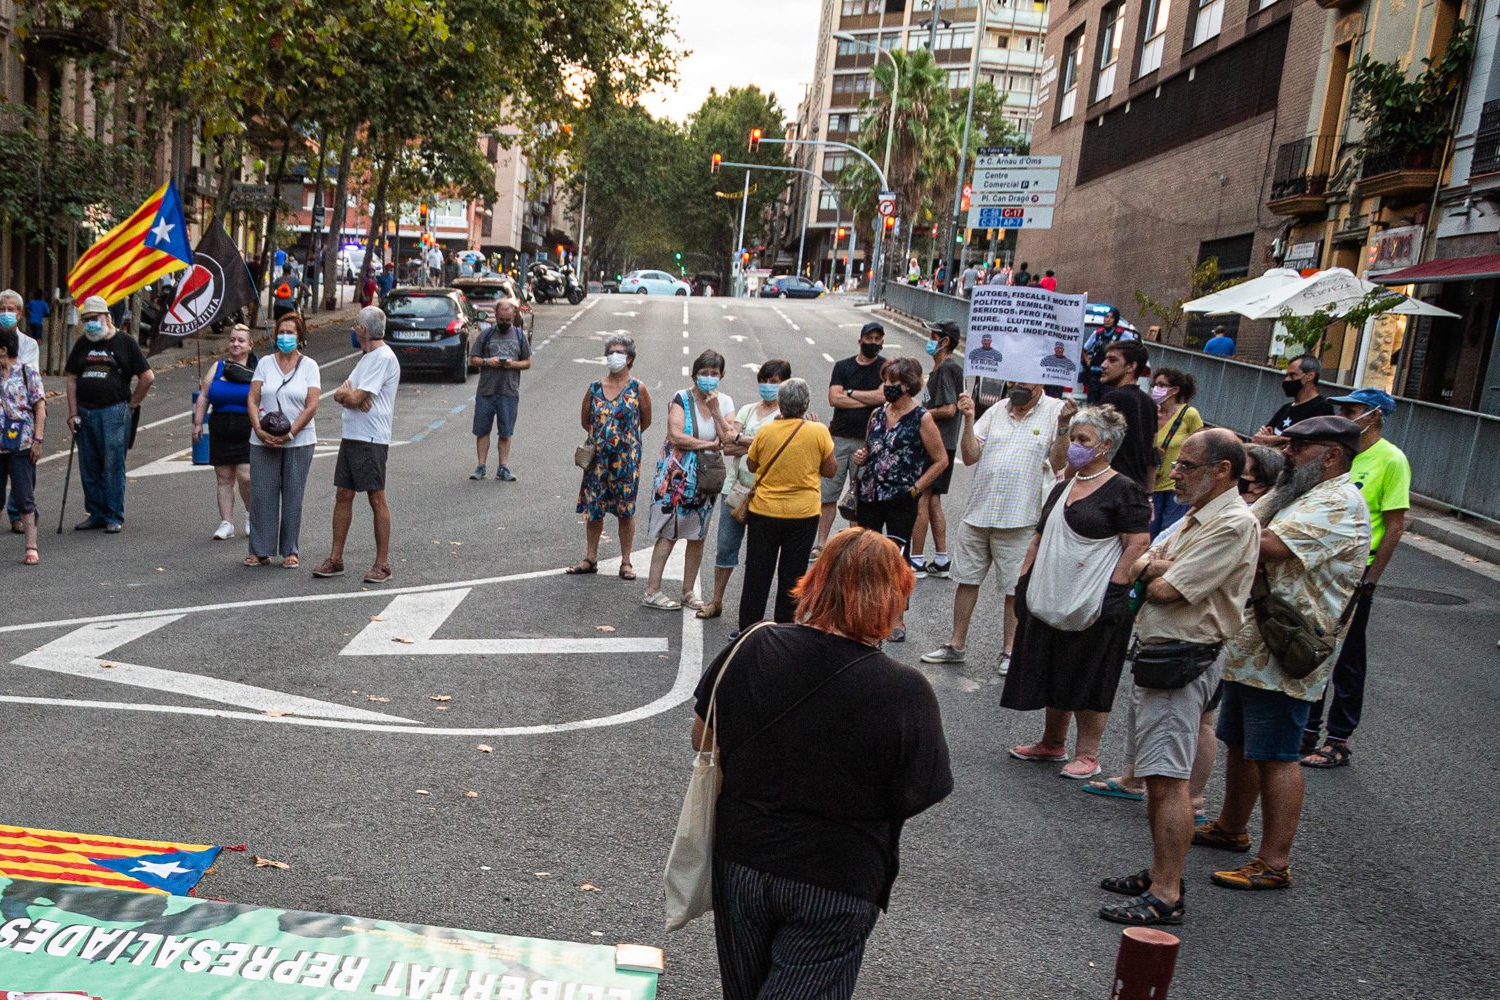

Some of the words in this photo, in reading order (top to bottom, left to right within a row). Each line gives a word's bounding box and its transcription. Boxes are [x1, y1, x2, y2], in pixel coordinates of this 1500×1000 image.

[996, 157, 1017, 166] Arnau
[1019, 157, 1042, 166] d'Oms
[984, 171, 1009, 180] Centre
[983, 180, 1019, 189] Comercial
[992, 194, 1007, 202] Can
[1008, 194, 1030, 203] Dragó
[1004, 208, 1022, 217] C-17
[1003, 218, 1021, 226] AP-7
[975, 290, 1010, 299] JUTGES,
[1012, 291, 1046, 301] FISCALS
[1052, 297, 1080, 307] MOLTS
[973, 298, 1012, 307] POLÍTICS
[1016, 300, 1054, 311] SEMBLEN
[1019, 309, 1041, 318] PERÒ
[1043, 312, 1057, 321] FAN
[1006, 317, 1042, 327] LLUITEM
[1045, 322, 1060, 331] PER
[1061, 326, 1080, 334] UNA
[971, 324, 1019, 334] REPÚBLICA
[1023, 328, 1080, 342] INDEPENDENT
[1045, 367, 1070, 376] WANTED
